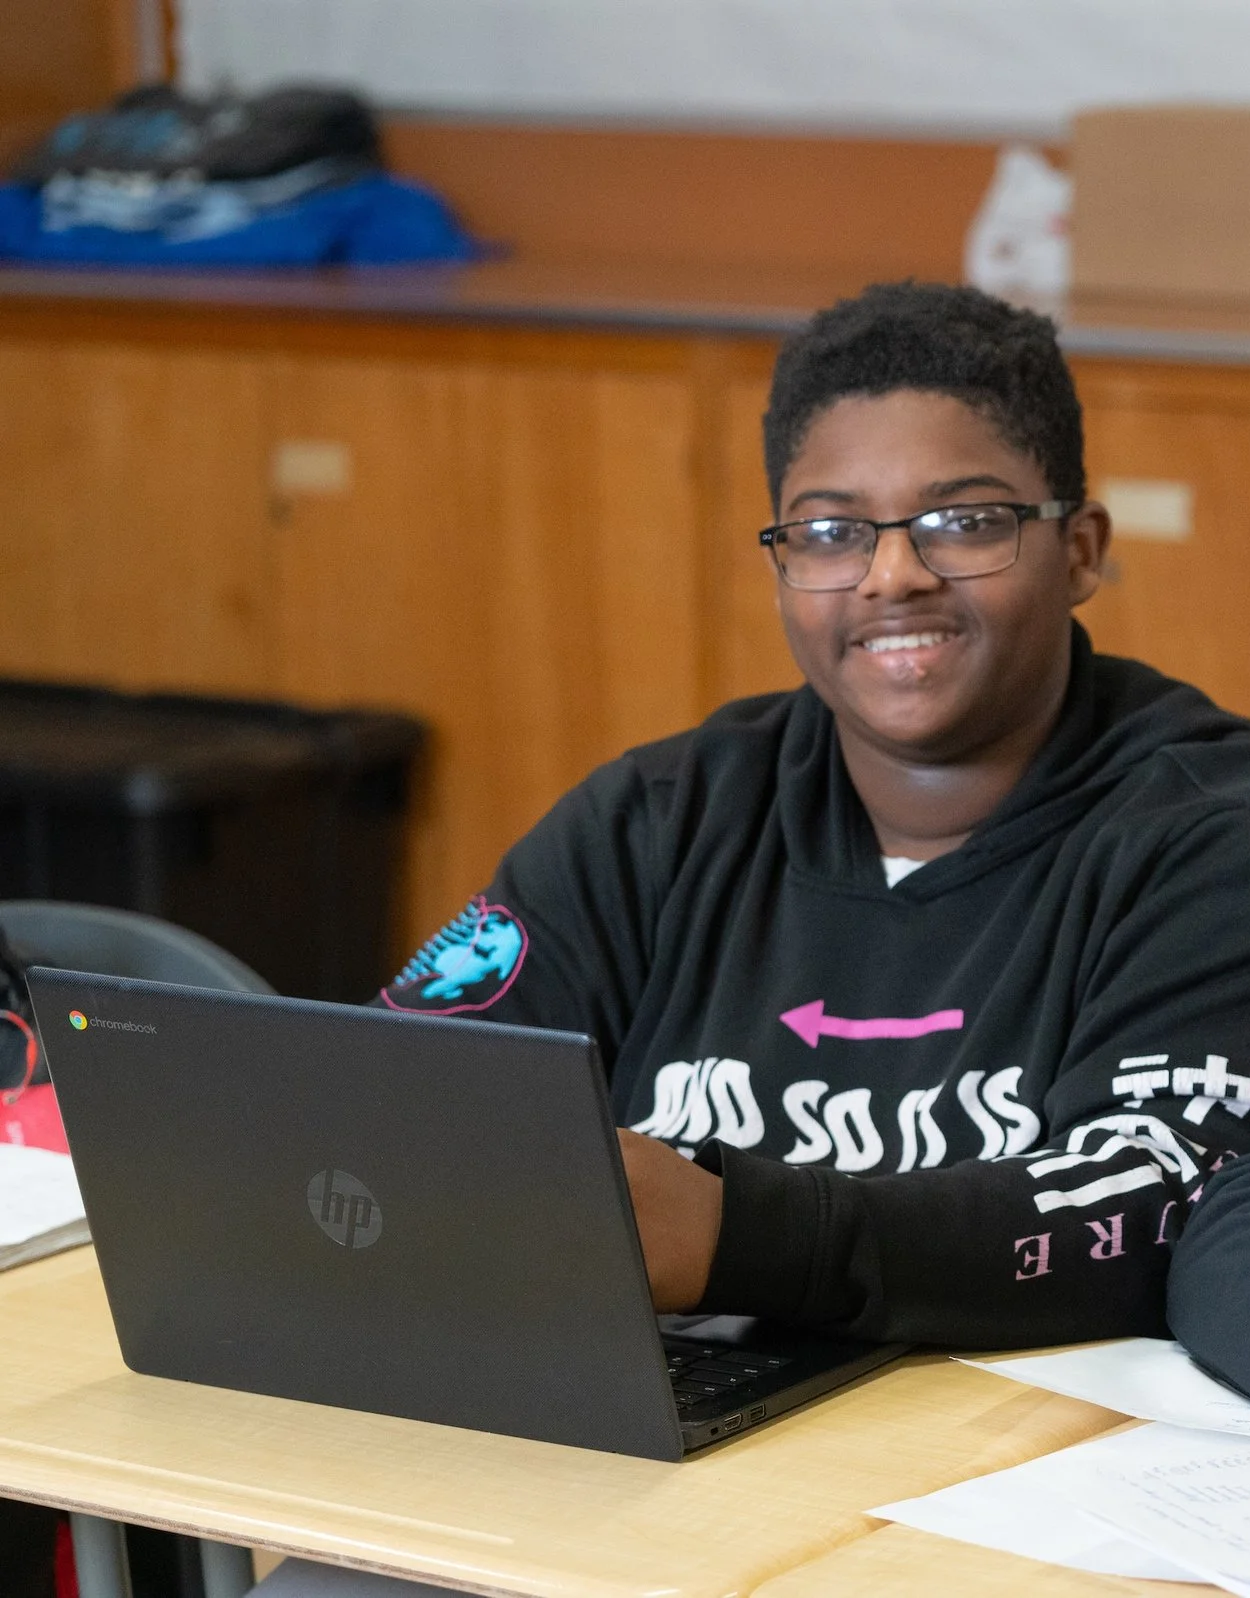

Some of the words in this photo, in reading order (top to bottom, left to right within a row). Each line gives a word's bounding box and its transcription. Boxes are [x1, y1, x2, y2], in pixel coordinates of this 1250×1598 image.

[90, 1016, 158, 1034] chromebook
[629, 1057, 765, 1149] AND
[783, 1080, 884, 1172] SO
[957, 1066, 1040, 1161] IS
[318, 1167, 375, 1250] hp
